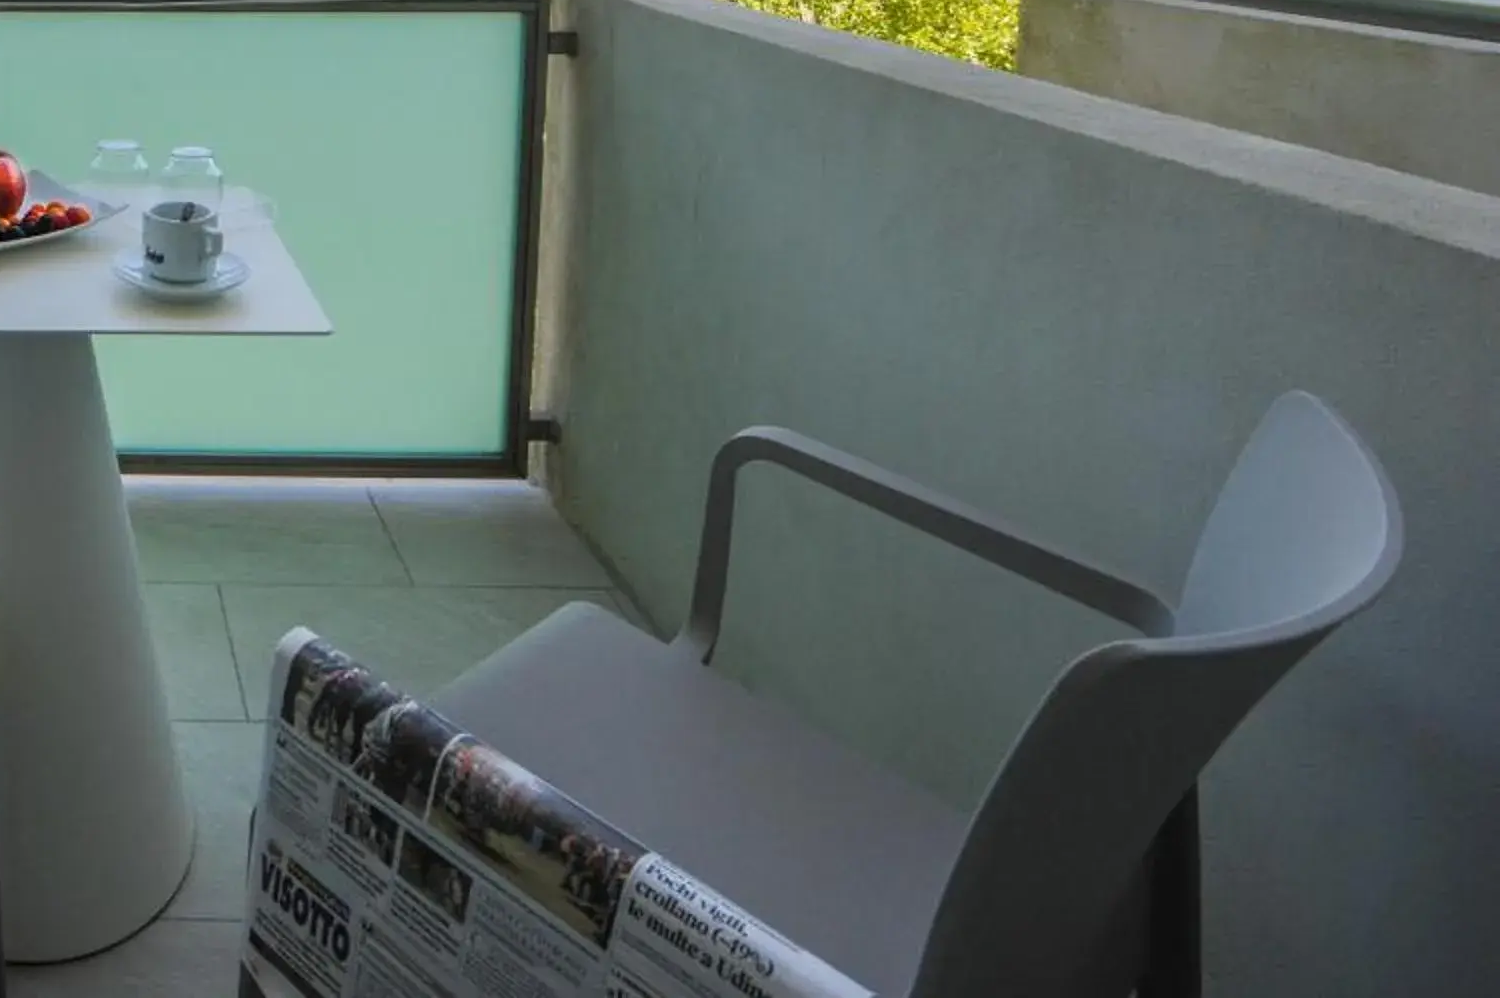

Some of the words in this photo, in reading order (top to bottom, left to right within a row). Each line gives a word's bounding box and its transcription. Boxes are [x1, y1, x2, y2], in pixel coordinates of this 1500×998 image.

[261, 853, 350, 962] VISOTTO
[635, 880, 709, 936] crollano
[646, 864, 698, 901] Pochi
[627, 895, 645, 921] le
[646, 914, 699, 959] multe
[700, 952, 713, 969] a
[717, 955, 772, 998] Udin
